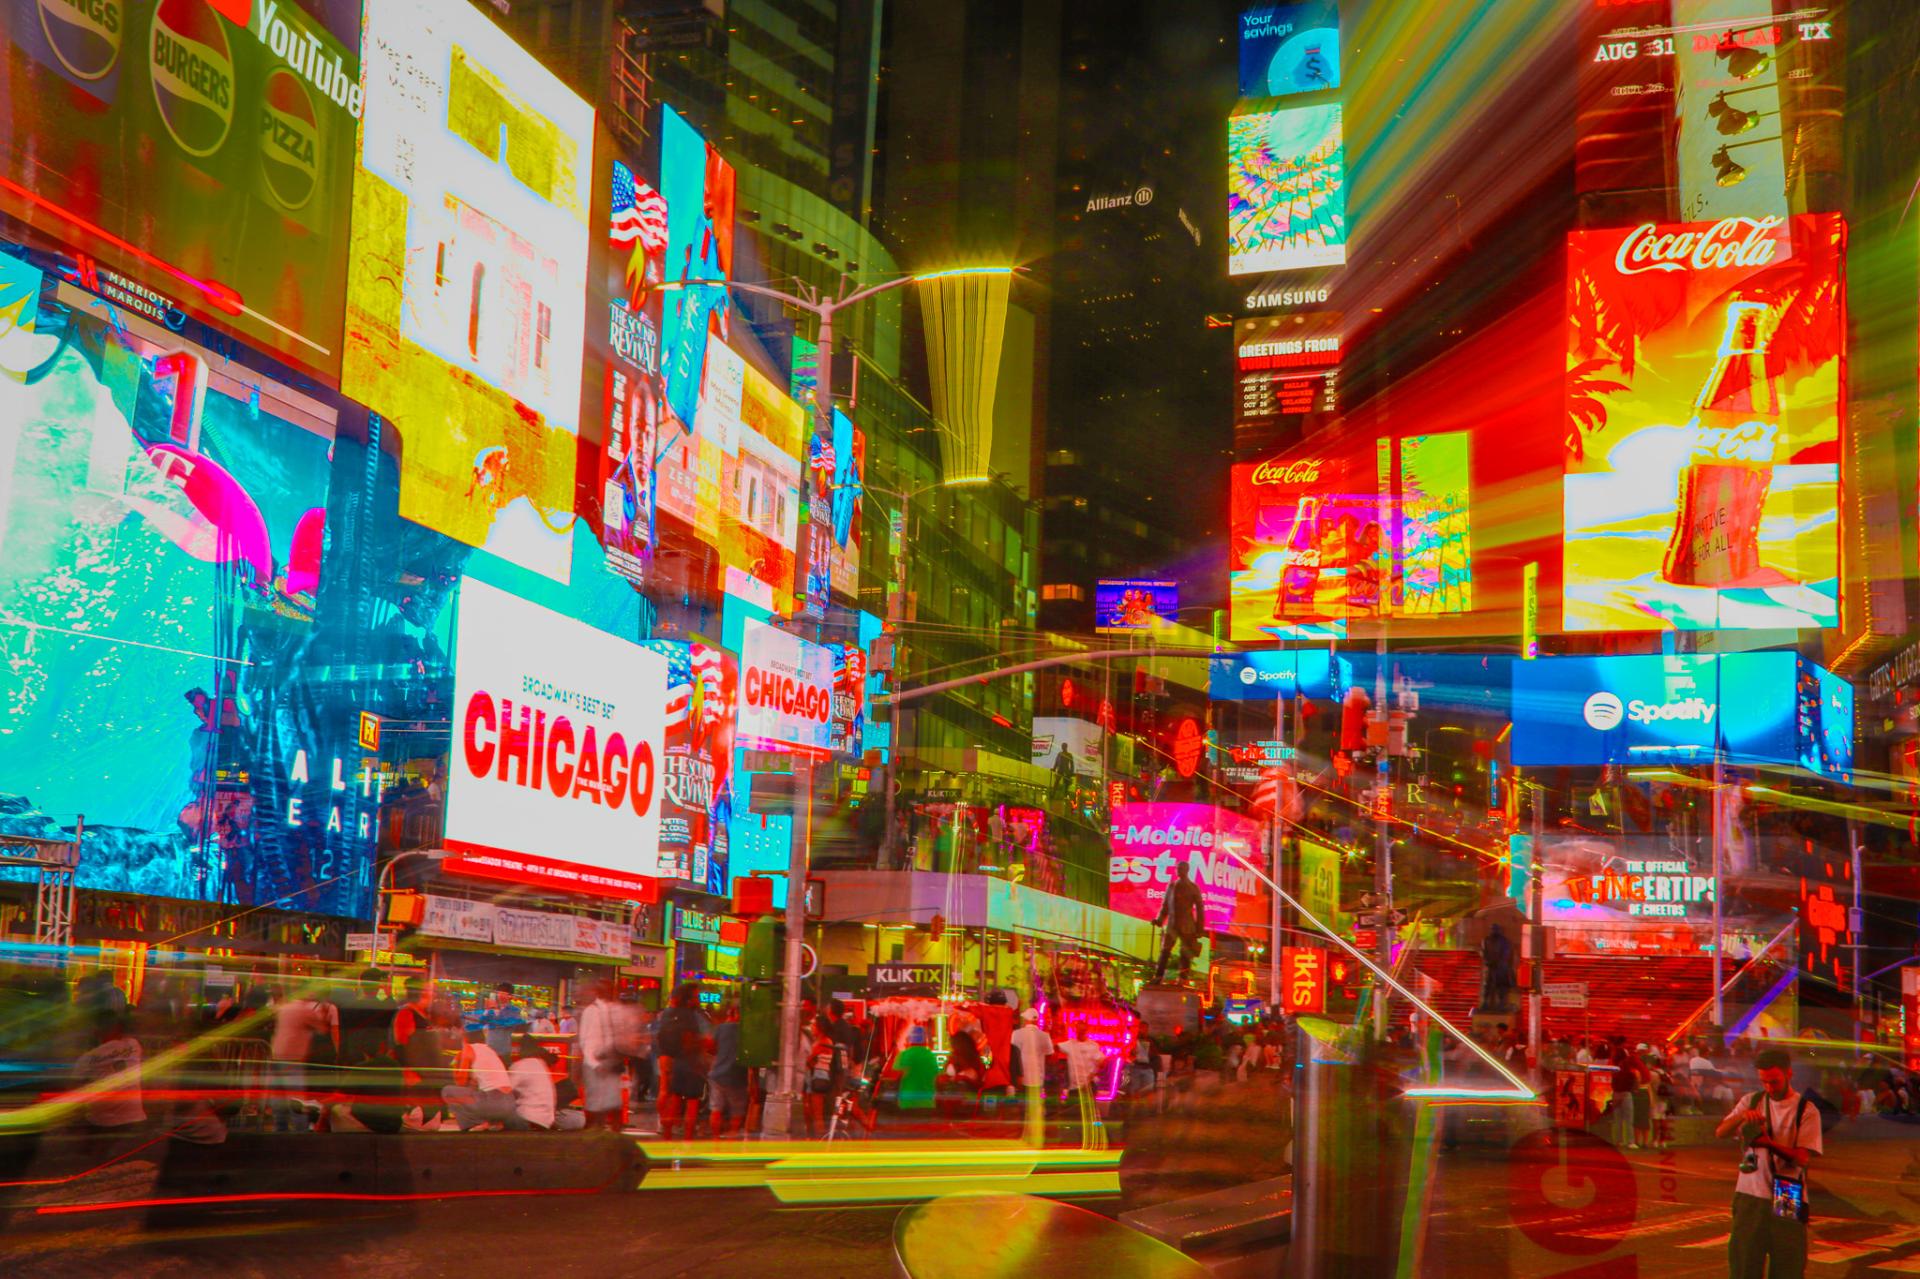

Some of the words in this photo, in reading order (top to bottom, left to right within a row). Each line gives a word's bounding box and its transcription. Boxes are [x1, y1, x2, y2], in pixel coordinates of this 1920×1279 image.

[1244, 15, 1272, 26] Your
[1244, 23, 1293, 40] savings
[1594, 41, 1637, 62] AUG
[1650, 38, 1676, 56] 31
[1798, 22, 1831, 41] TX
[154, 27, 230, 110] BURGERS
[257, 0, 363, 118] YouTube
[260, 108, 315, 169] PIZZA
[1086, 195, 1132, 213] Allianz
[1615, 215, 1784, 275] Coca-Cola
[106, 285, 165, 321] MARQUIS
[109, 272, 174, 310] MARRIOTT
[1246, 289, 1329, 309] SAMSUNG
[1239, 341, 1303, 358] GREETINGS
[1305, 338, 1339, 352] FROM
[1252, 458, 1326, 485] Coca-Cola
[1259, 671, 1297, 682] Spotify
[745, 666, 831, 724] CHICAGO
[1628, 698, 1716, 725] Spotify
[464, 689, 655, 818] CHICAGO
[1188, 850, 1257, 896] Network
[1627, 861, 1645, 872] THE
[1645, 861, 1689, 873] OFFICIAL
[1147, 889, 1167, 899] Bes
[876, 968, 941, 983] KLIKTIX
[1292, 949, 1319, 1007] tkts
